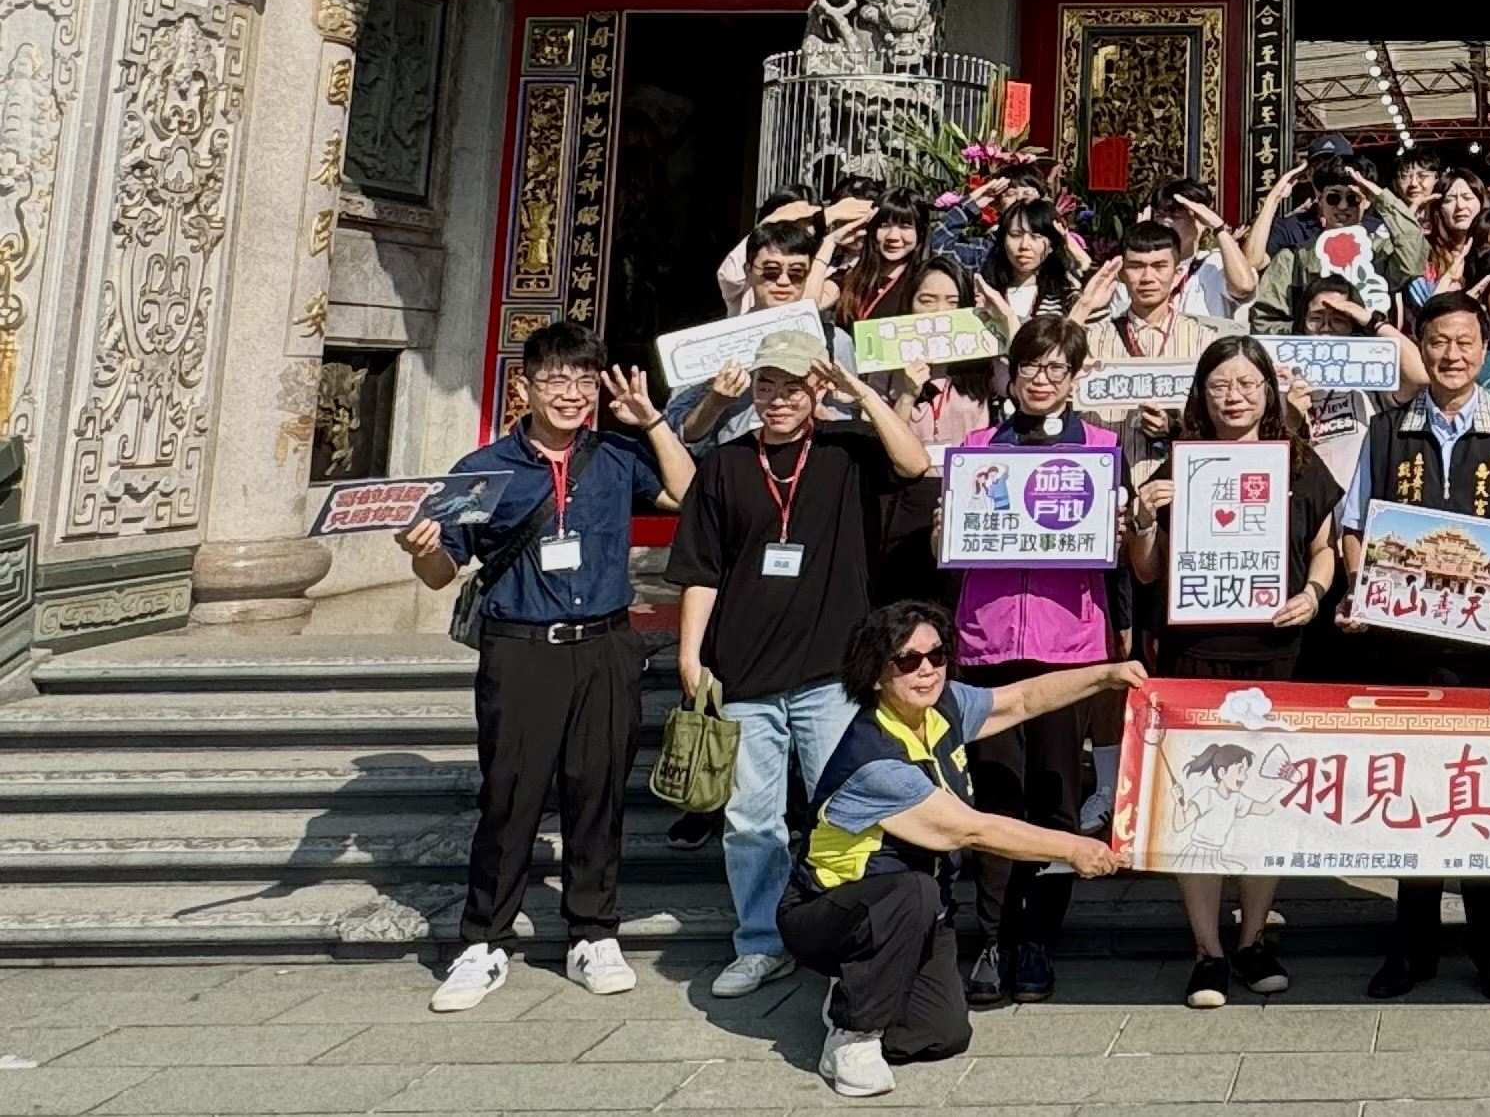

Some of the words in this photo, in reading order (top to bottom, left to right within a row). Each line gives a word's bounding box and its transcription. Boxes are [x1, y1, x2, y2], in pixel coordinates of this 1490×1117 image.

[963, 512, 1020, 532] 高雄市
[961, 532, 1096, 553] 茄萣戶政事務所
[1177, 549, 1281, 571] 高雄市政府
[1176, 574, 1281, 610] 民政局
[1290, 852, 1418, 869] 高雄市政府民政局
